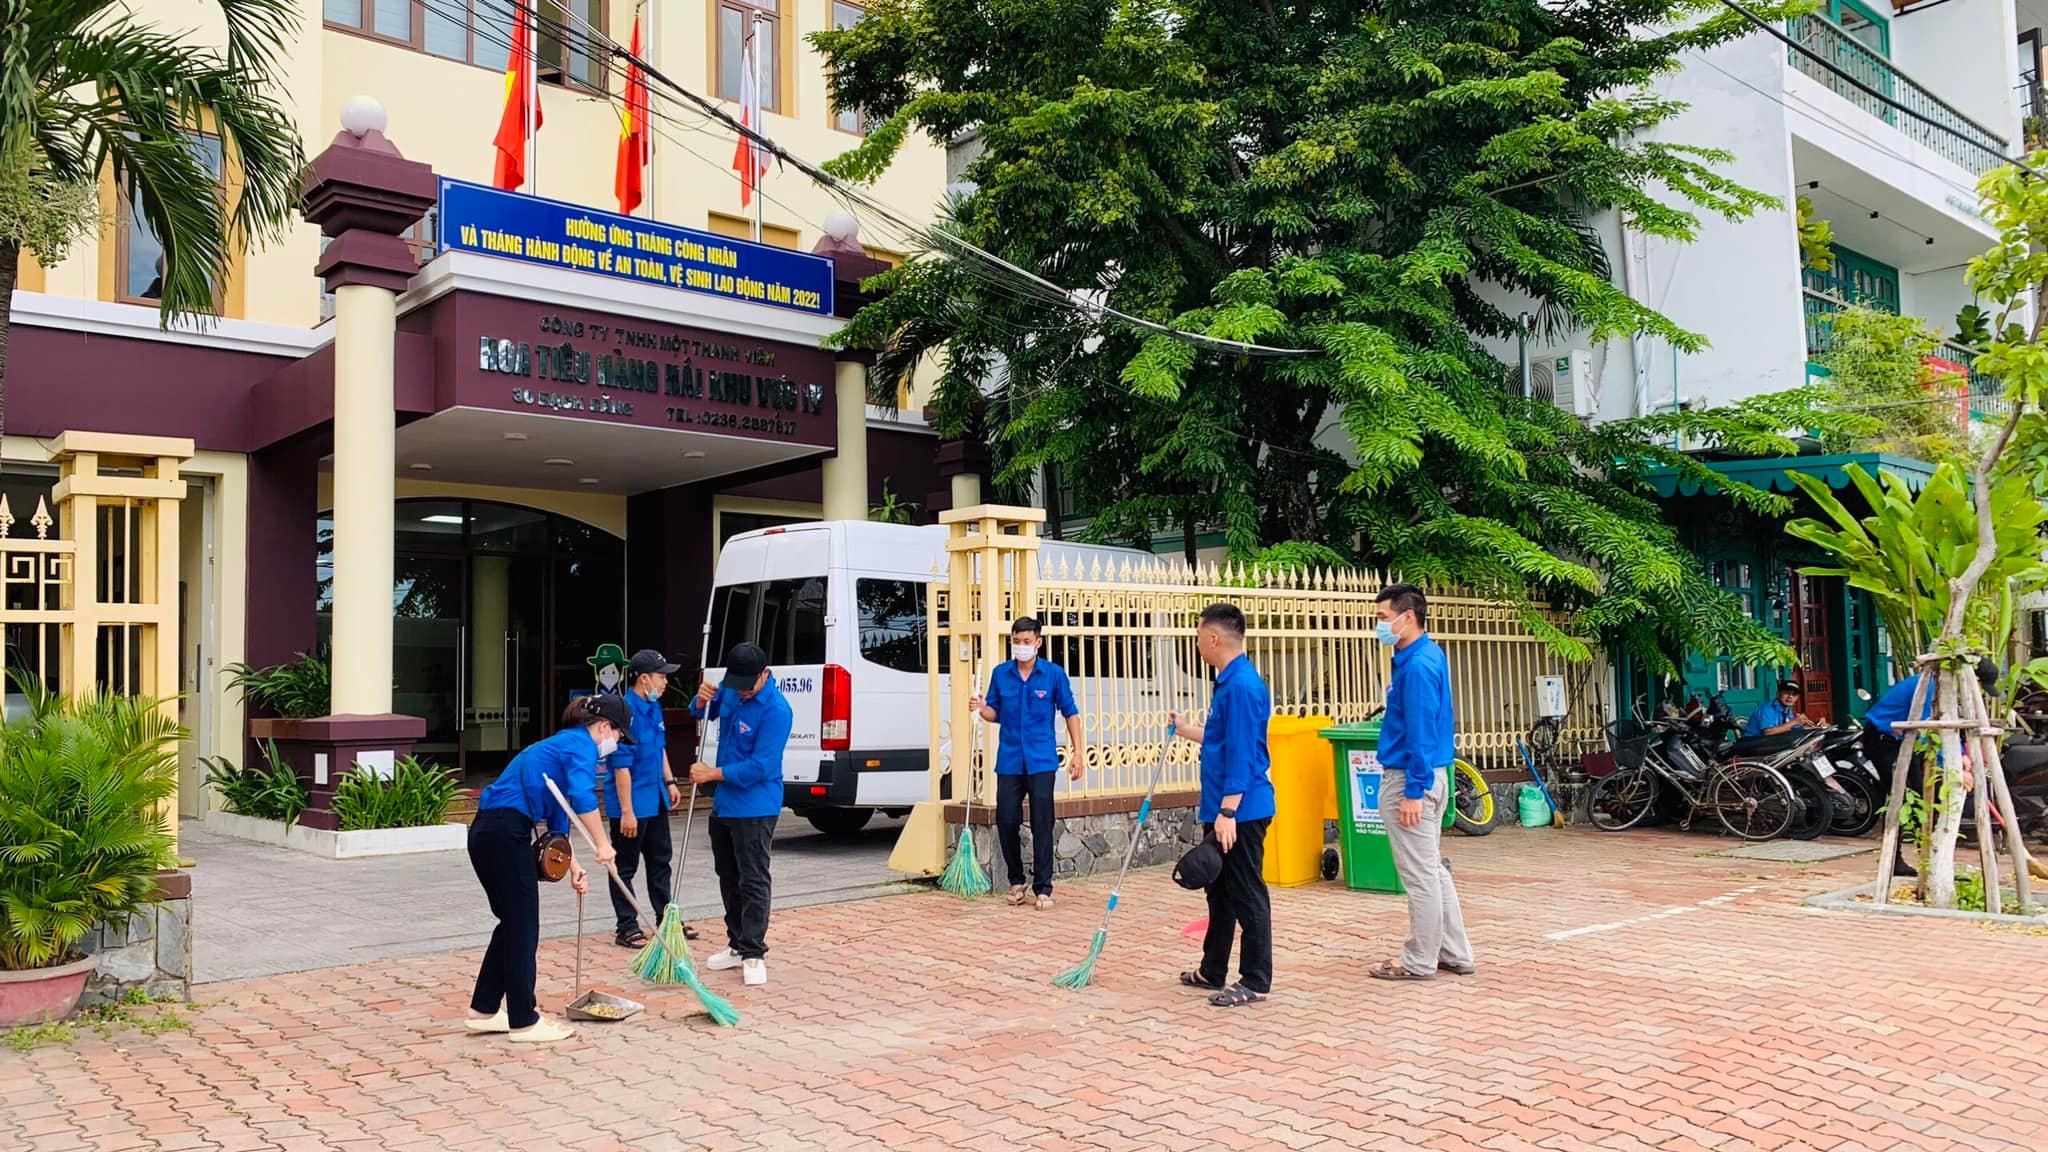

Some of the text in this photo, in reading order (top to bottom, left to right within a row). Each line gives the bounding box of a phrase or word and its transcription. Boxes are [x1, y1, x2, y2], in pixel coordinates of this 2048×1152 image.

[460, 224, 478, 247] VÀ
[481, 229, 522, 255] THÁNG
[526, 236, 559, 261] HÀNH
[562, 243, 595, 269] ĐỘNG
[615, 255, 631, 275] AN
[634, 259, 666, 283] TOÀN,
[669, 263, 683, 287] VỆ
[686, 269, 712, 289] SINH
[714, 274, 734, 293] LAO
[736, 276, 765, 299] ĐỘNG
[767, 282, 791, 304] NĂM
[793, 289, 821, 309] 2022!
[609, 223, 633, 248] ỨNG
[636, 229, 672, 255] THÁNG
[674, 238, 705, 262] CÔNG
[707, 246, 737, 268] NHÂN
[539, 314, 584, 338] CÔNG
[589, 324, 609, 342] TY
[615, 328, 657, 349] TNHH
[660, 333, 690, 357] MỘT
[479, 336, 531, 376] HOA
[708, 370, 752, 406] KHU
